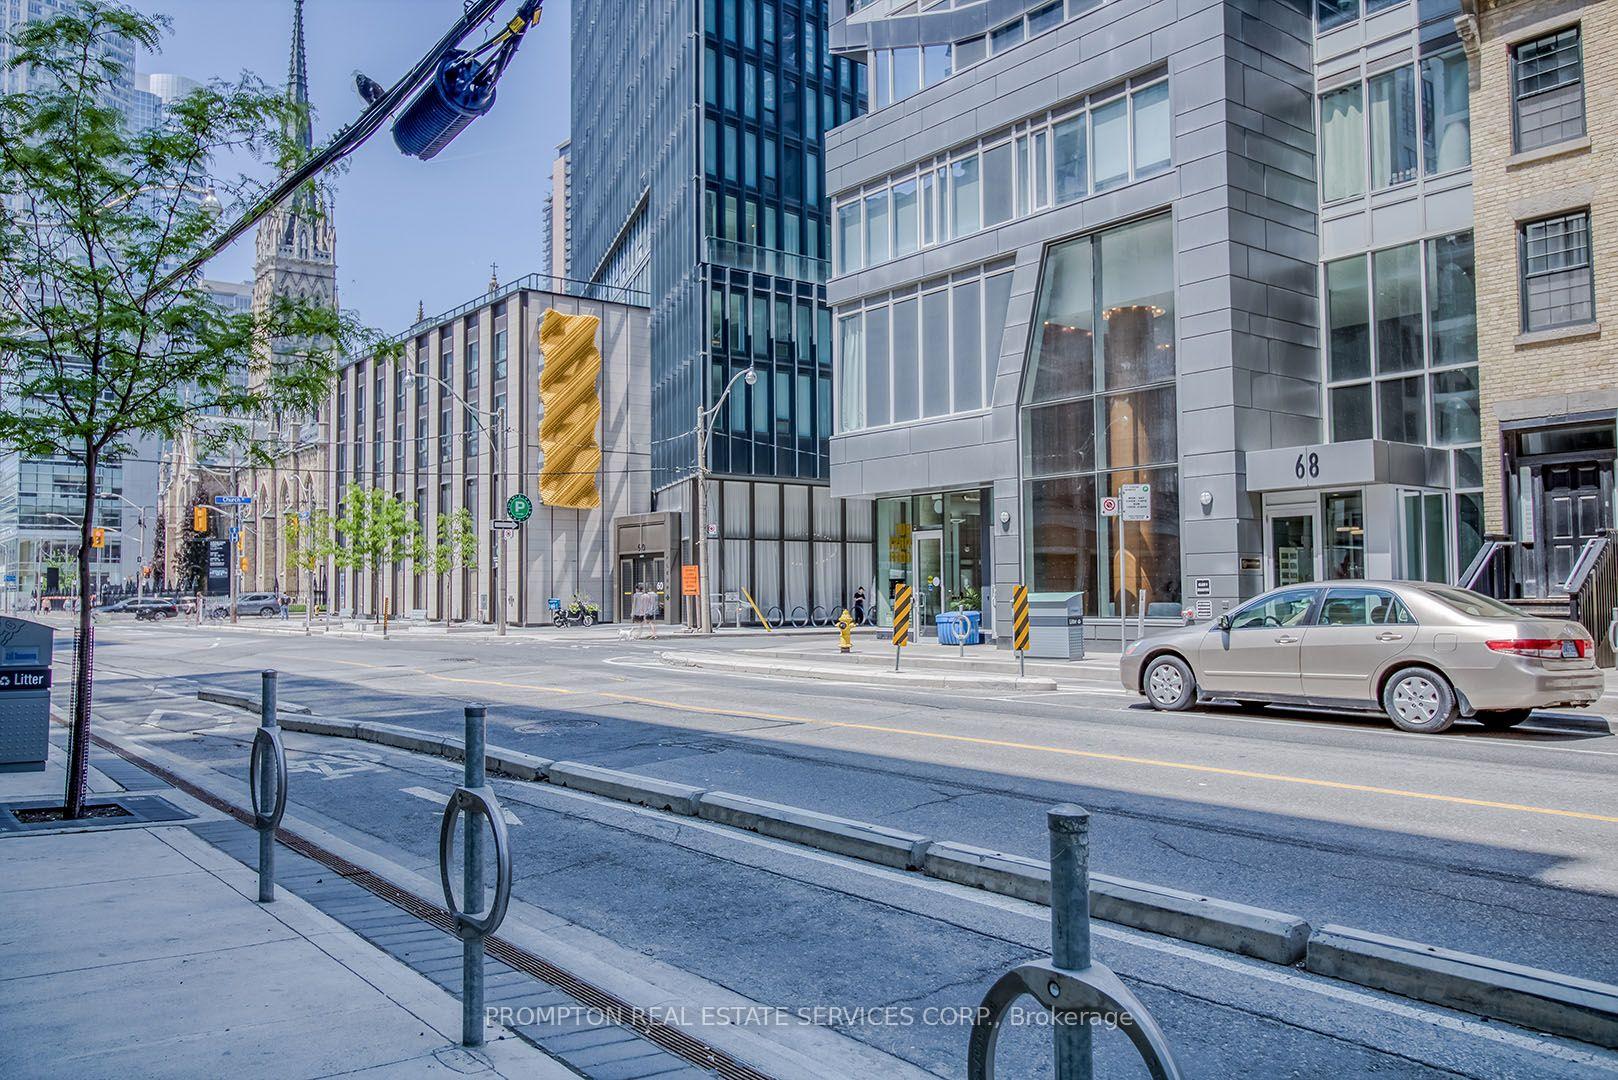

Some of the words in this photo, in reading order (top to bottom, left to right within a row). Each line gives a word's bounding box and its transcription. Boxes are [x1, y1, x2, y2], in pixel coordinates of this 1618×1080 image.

[1295, 452, 1320, 479] 68
[514, 500, 526, 512] P
[232, 532, 238, 542] H
[14, 673, 44, 685] Litter
